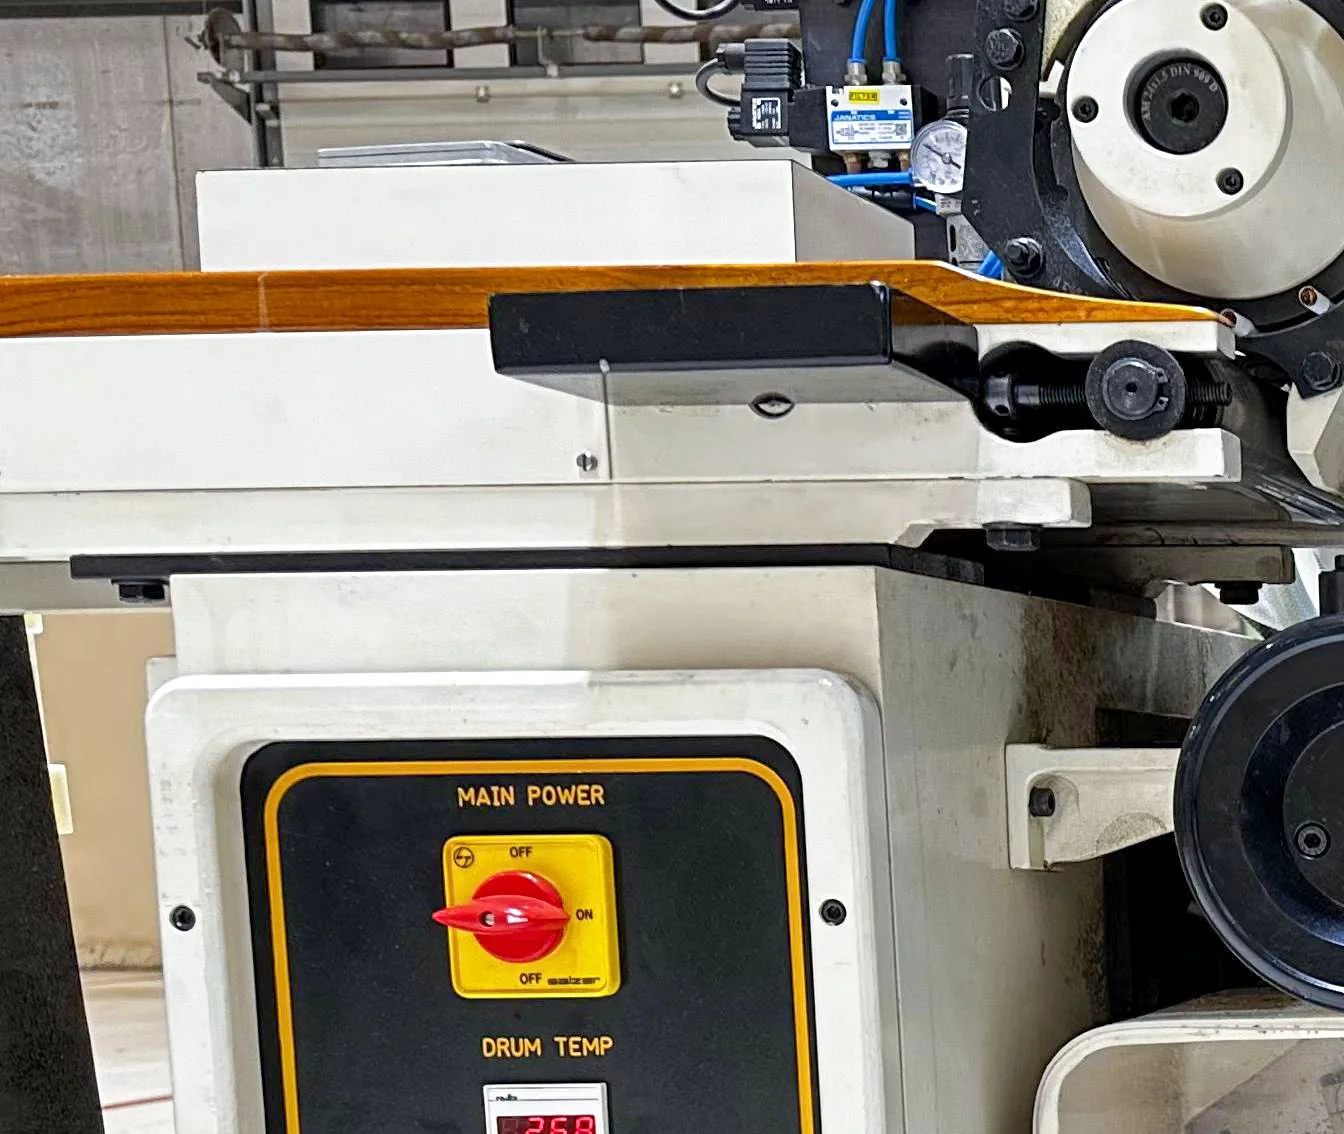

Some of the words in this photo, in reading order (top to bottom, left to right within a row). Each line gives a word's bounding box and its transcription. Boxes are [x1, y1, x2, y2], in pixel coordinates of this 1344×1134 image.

[1170, 63, 1193, 78] DIN
[1208, 81, 1219, 92] D
[457, 786, 515, 807] MAIN
[527, 784, 605, 806] POWER
[510, 846, 532, 858] OFF
[576, 909, 593, 920] ON
[520, 973, 542, 985] OFF
[482, 1037, 542, 1058] DRUM
[553, 1036, 613, 1057] TEMP
